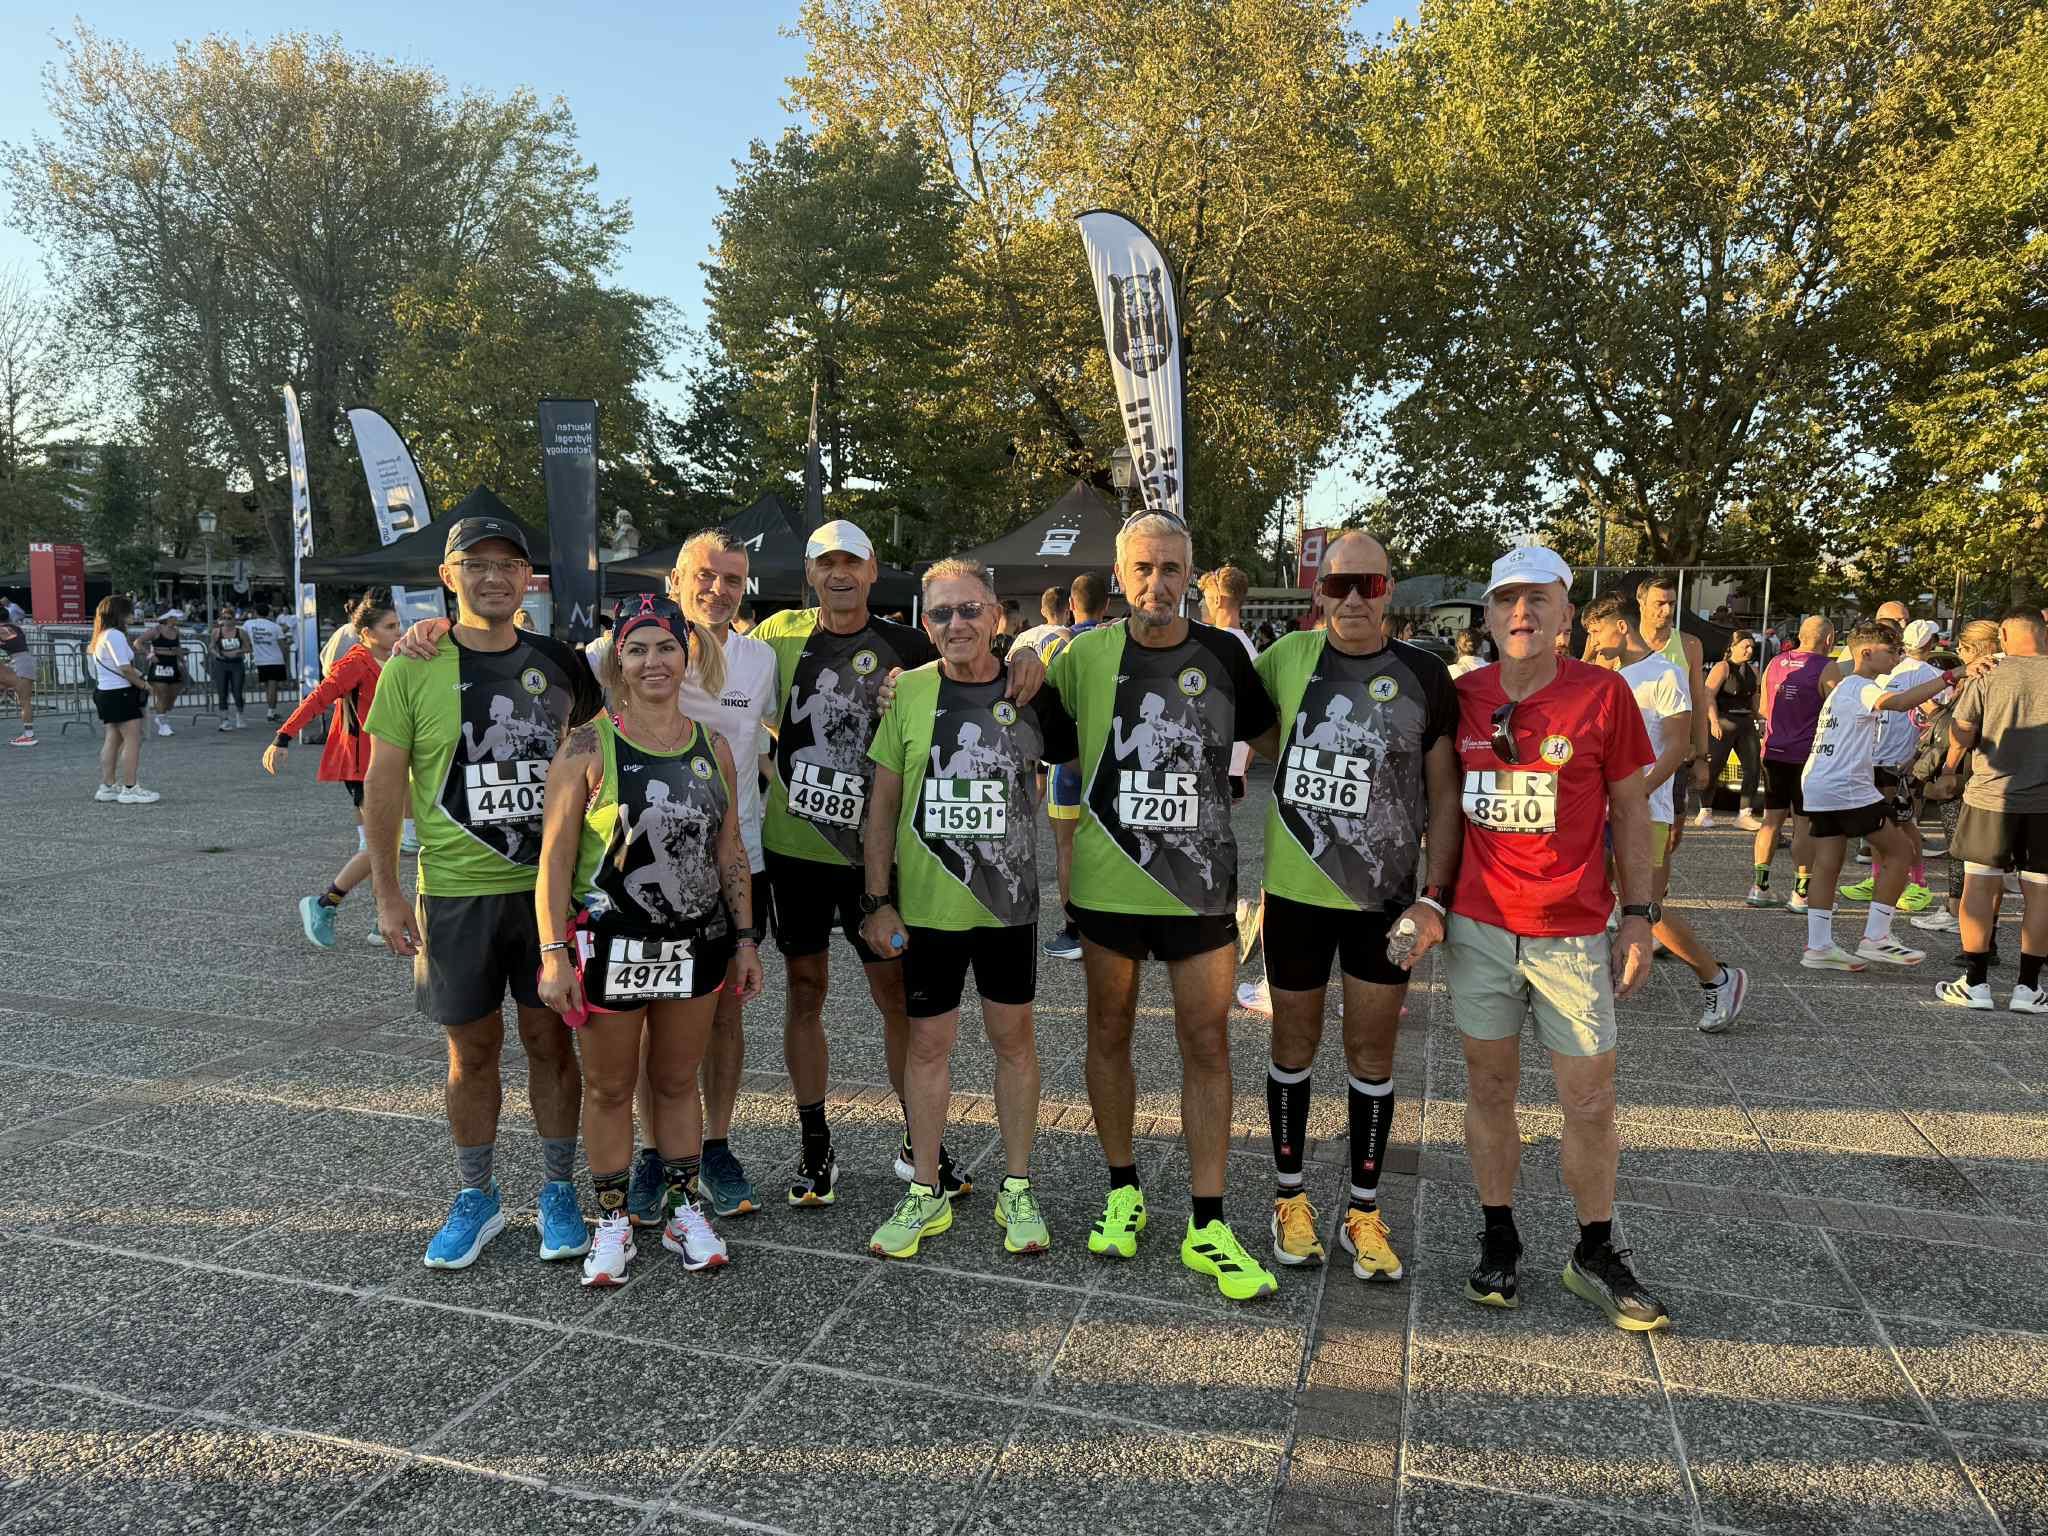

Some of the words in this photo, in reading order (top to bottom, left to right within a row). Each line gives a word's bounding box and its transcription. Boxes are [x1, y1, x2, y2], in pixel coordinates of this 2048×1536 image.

[465, 760, 551, 787] ILR
[1287, 746, 1371, 781] ILR
[791, 761, 865, 796] ILR
[925, 779, 1006, 802] ILR
[1120, 770, 1198, 795] ILR
[1295, 774, 1357, 807] 8316
[1464, 771, 1555, 795] ILR
[795, 788, 856, 819] 4988
[1130, 797, 1188, 822] 7201
[1474, 797, 1542, 823] 8510
[937, 806, 993, 829] 1591
[609, 938, 694, 963] ILR
[614, 964, 684, 988] 4974
